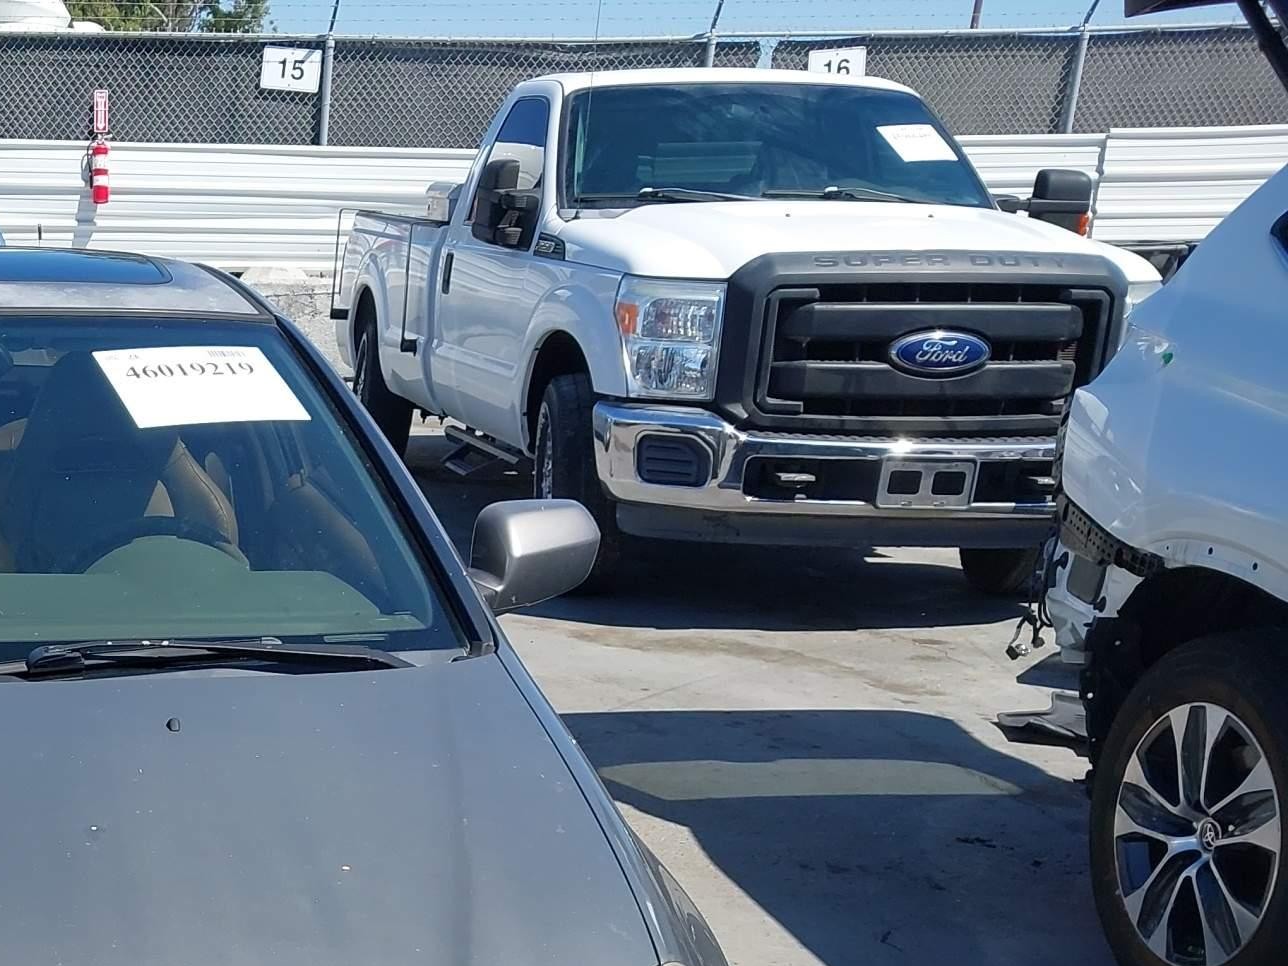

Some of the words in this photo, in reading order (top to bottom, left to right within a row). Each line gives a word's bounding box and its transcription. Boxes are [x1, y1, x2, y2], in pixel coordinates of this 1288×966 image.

[278, 57, 304, 80] 15
[824, 59, 850, 75] 16
[814, 254, 951, 267] SUPER
[969, 255, 1068, 268] DUTY
[915, 339, 970, 363] Ford
[126, 361, 254, 379] 46019219
